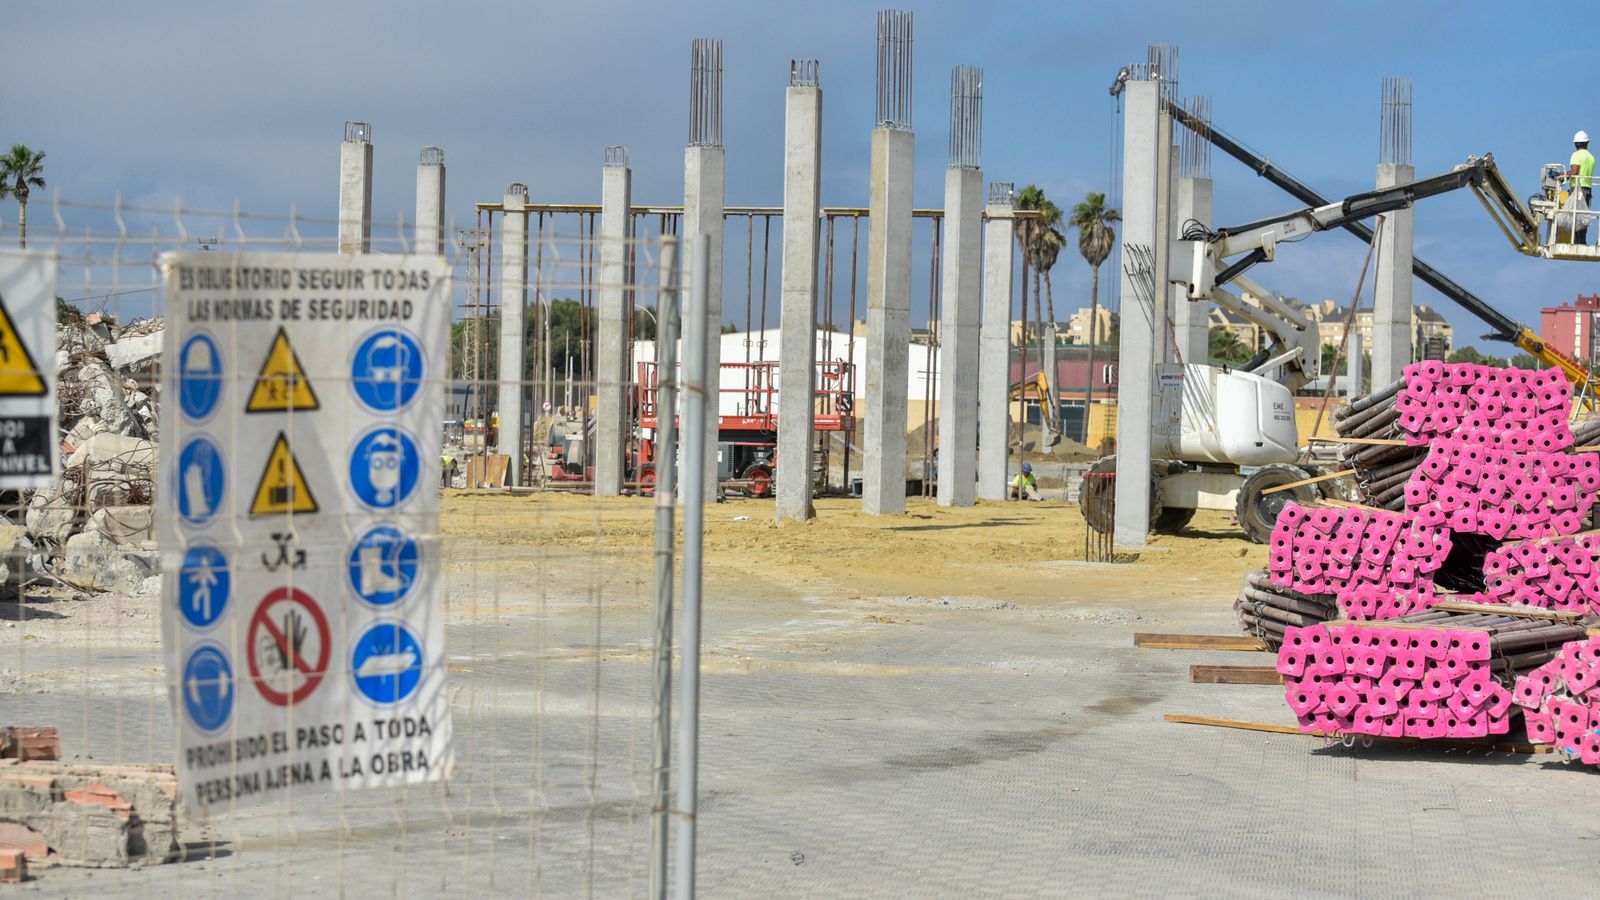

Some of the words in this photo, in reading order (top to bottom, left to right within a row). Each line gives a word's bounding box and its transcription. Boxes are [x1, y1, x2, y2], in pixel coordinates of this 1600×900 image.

[198, 266, 292, 290] OBLIGATORIO
[298, 268, 365, 290] SEGUIR
[372, 268, 430, 290] TODAS
[188, 299, 210, 321] LAS
[213, 299, 274, 321] NORMAS
[279, 299, 302, 321] DE
[308, 299, 413, 321] SEGURIDAD
[187, 734, 267, 770] PROHIBIDO
[271, 731, 289, 754] EL
[295, 722, 344, 750] PASO
[353, 720, 366, 743] A
[374, 715, 432, 740] TODA
[196, 771, 262, 806] PERSONA
[264, 762, 314, 790] AJENA
[320, 758, 332, 781] A
[339, 756, 363, 778] LA
[370, 749, 429, 775] OBRA
